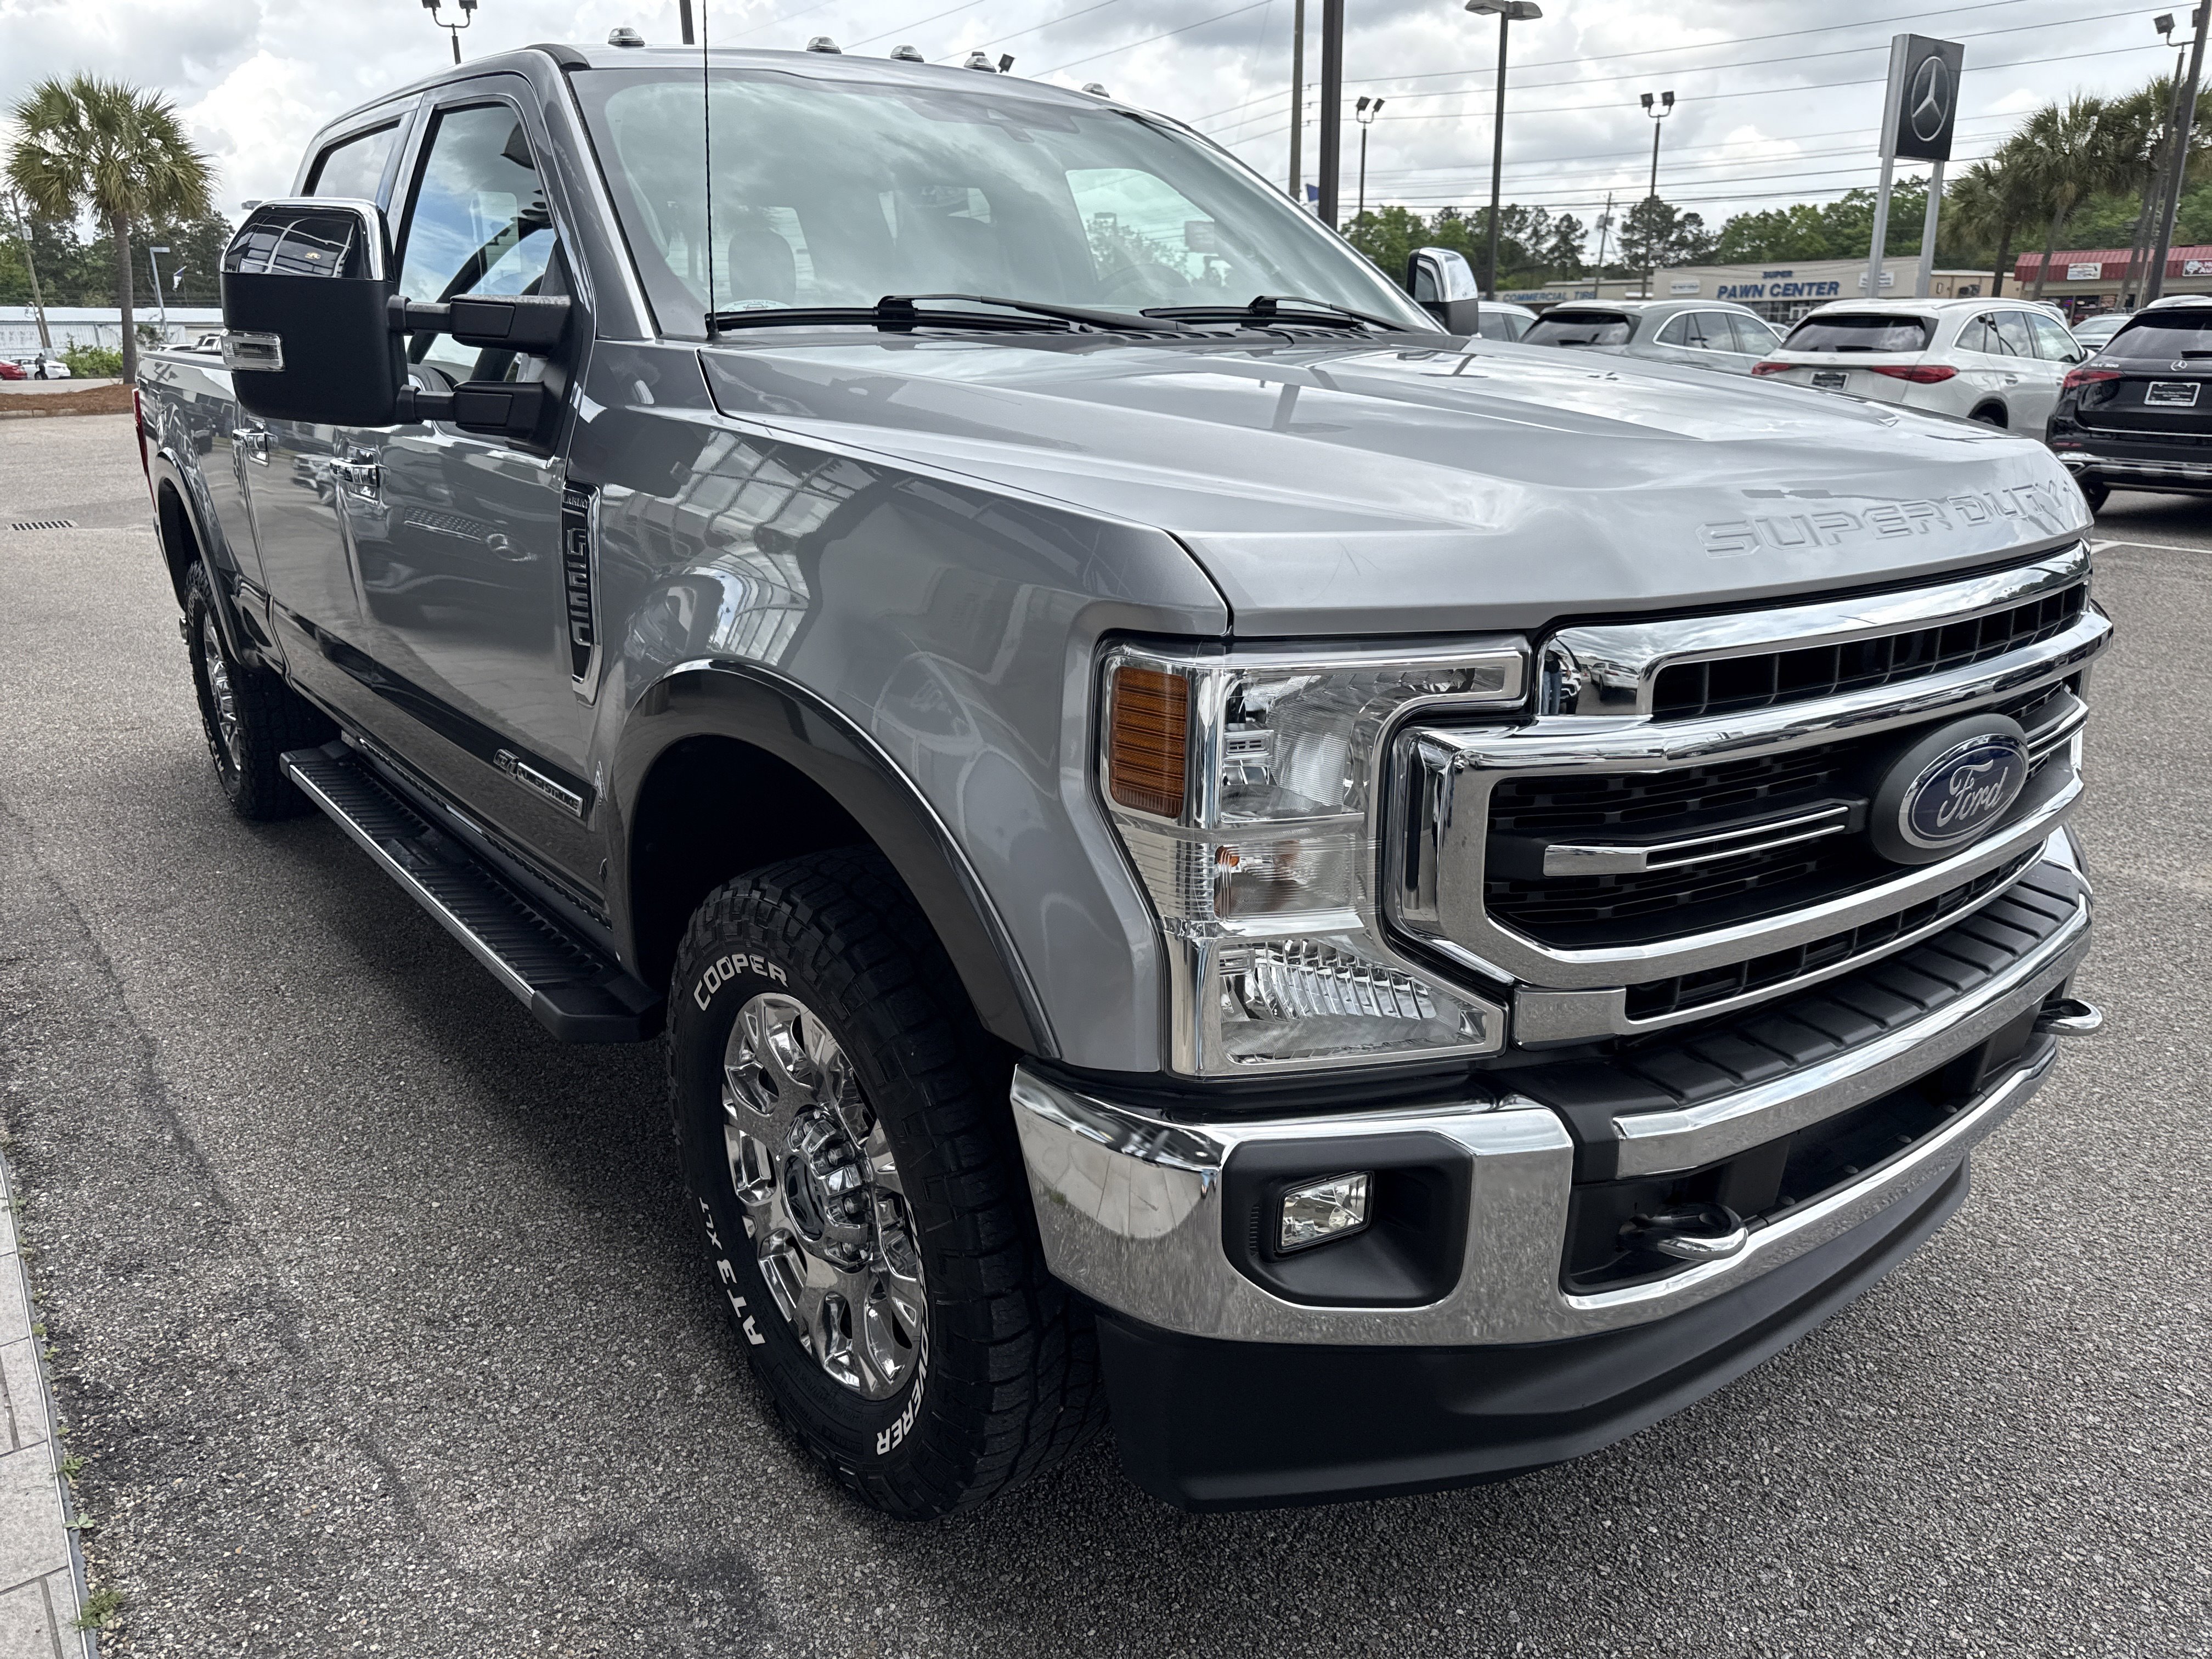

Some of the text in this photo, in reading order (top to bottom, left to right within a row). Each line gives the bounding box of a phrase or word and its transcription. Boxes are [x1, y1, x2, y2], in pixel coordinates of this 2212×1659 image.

[1503, 292, 1567, 302] COMMERCIAL
[1717, 281, 1839, 299] PAWN CENTER
[562, 494, 588, 509] LARIAT
[1695, 479, 2065, 558] SUPER DUTY
[1937, 759, 2008, 827] Ford
[693, 953, 788, 1011] COOPER
[699, 1197, 723, 1251] XLT
[716, 1259, 766, 1345] AT3
